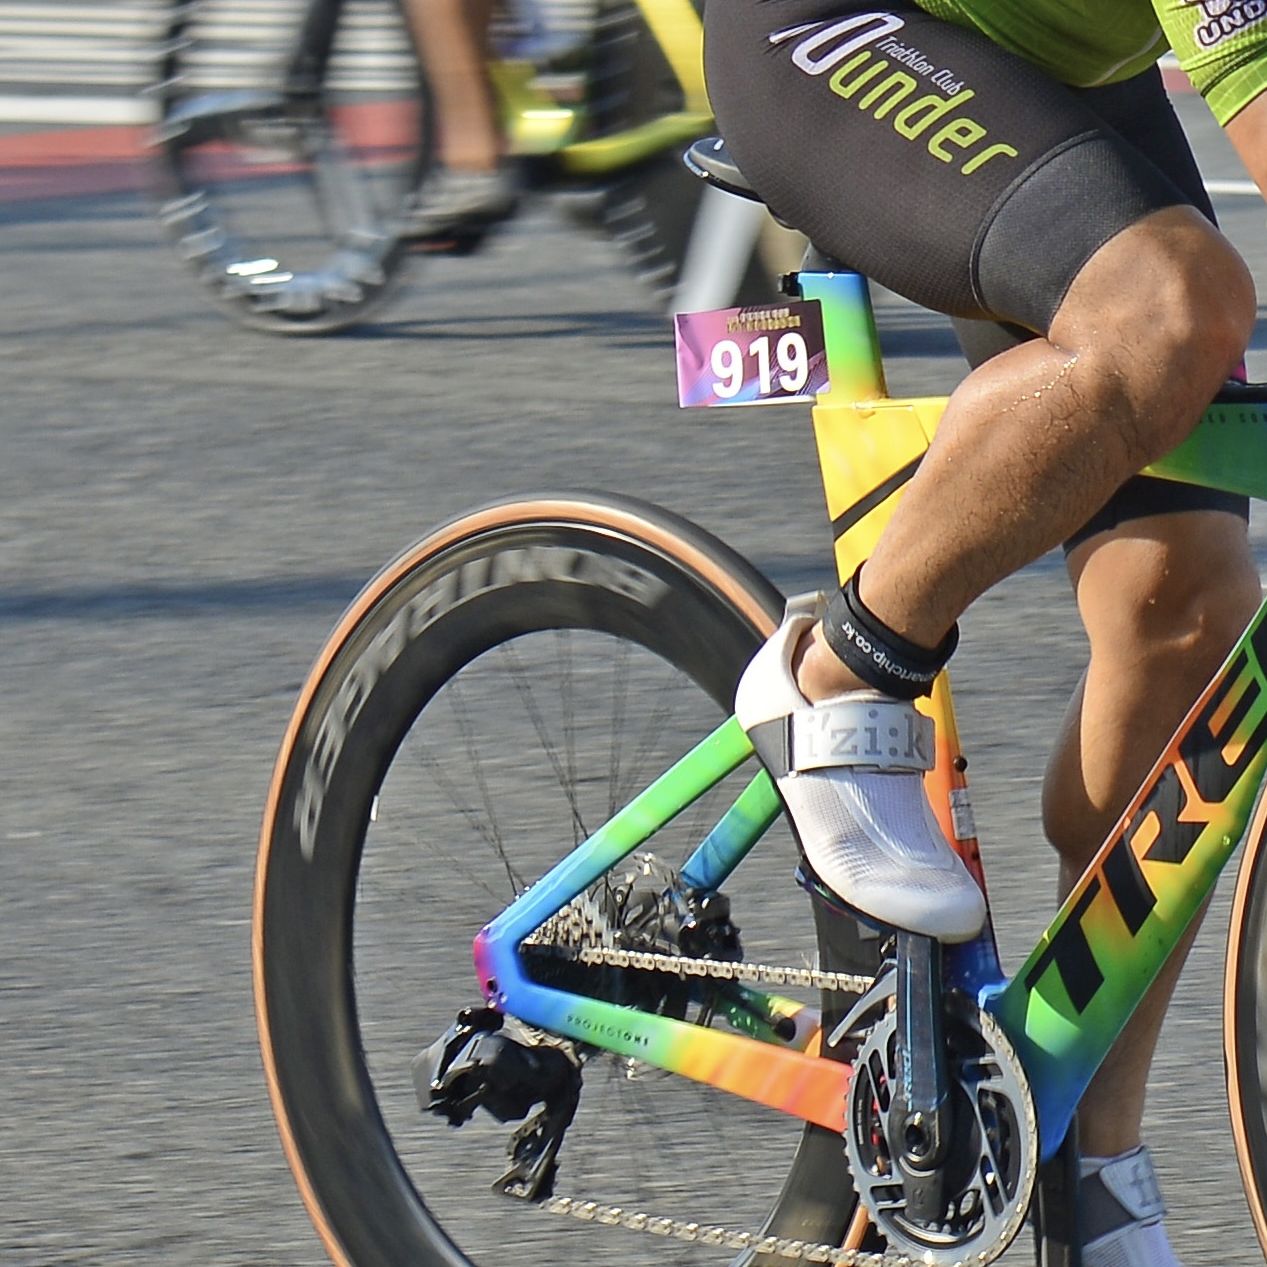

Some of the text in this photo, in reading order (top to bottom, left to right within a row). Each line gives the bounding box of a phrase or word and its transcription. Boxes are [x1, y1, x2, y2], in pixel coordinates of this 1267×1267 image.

[875, 36, 965, 96] Triathlon Club
[710, 331, 809, 399] 919
